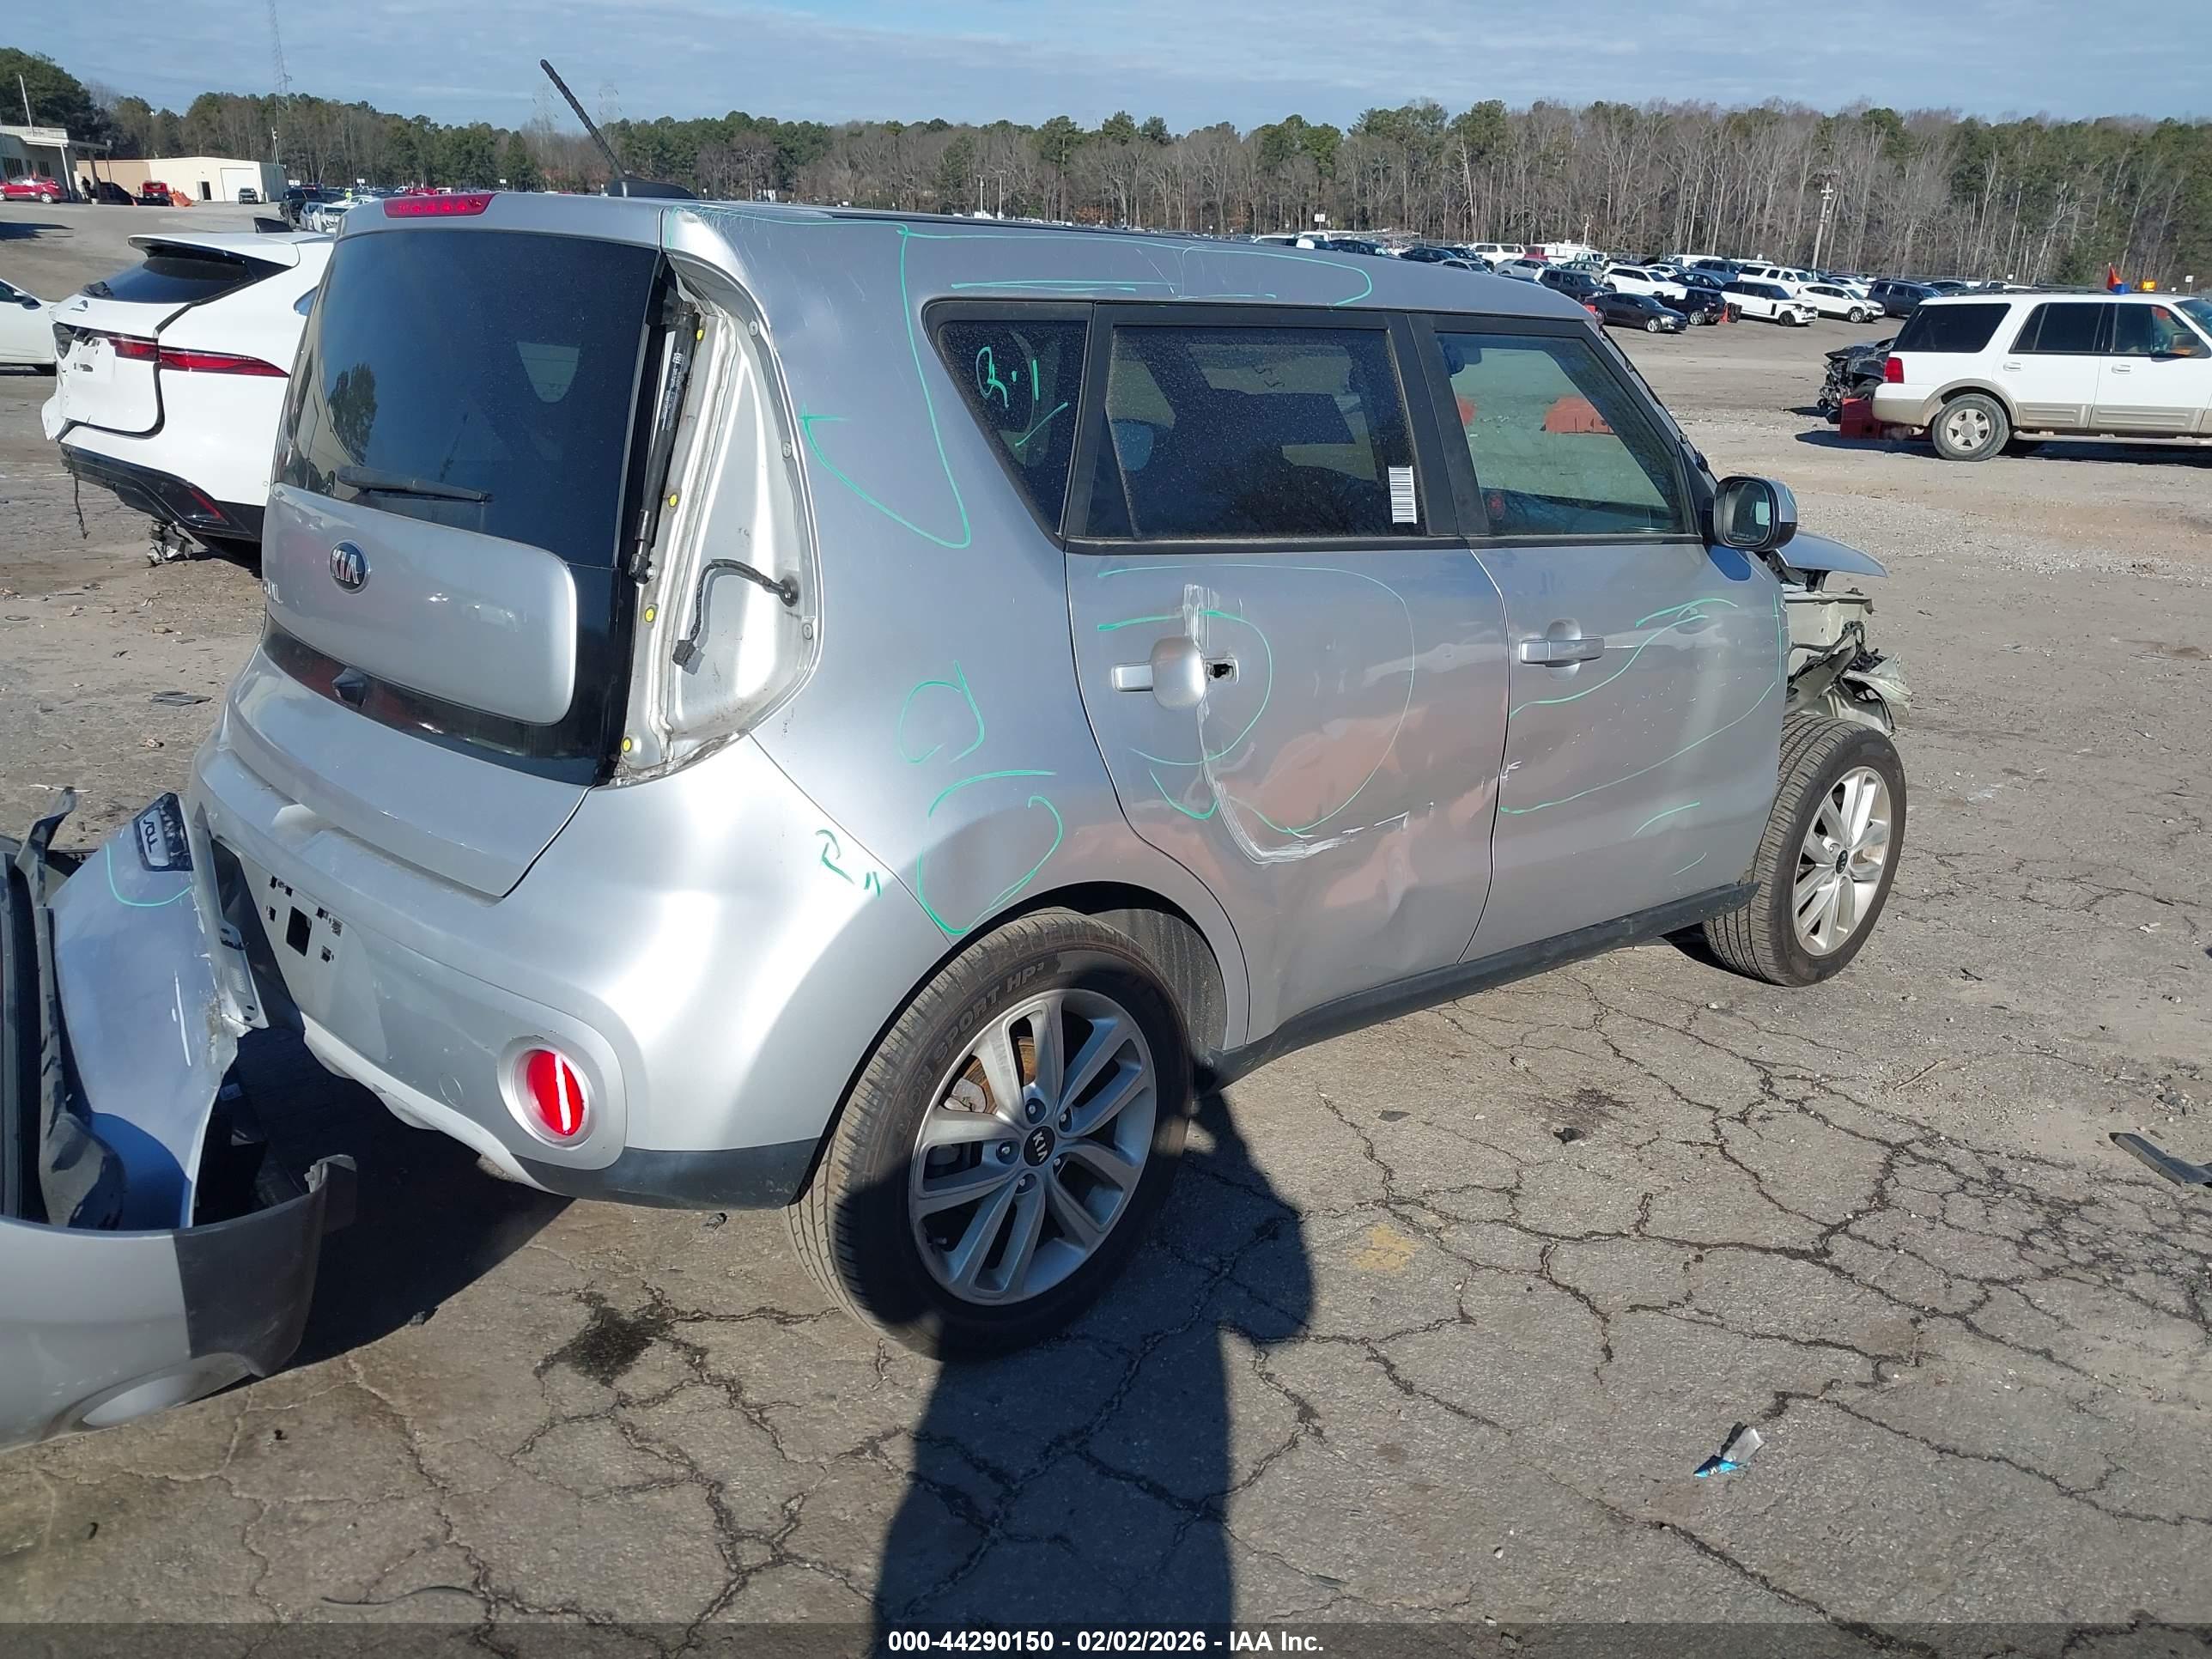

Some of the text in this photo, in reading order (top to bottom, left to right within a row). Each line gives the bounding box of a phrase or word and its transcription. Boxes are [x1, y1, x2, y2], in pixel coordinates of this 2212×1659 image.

[331, 549, 360, 586] KIA
[143, 818, 159, 854] SOUL
[933, 986, 1000, 1062] SPORT
[1032, 1131, 1048, 1164] KIA
